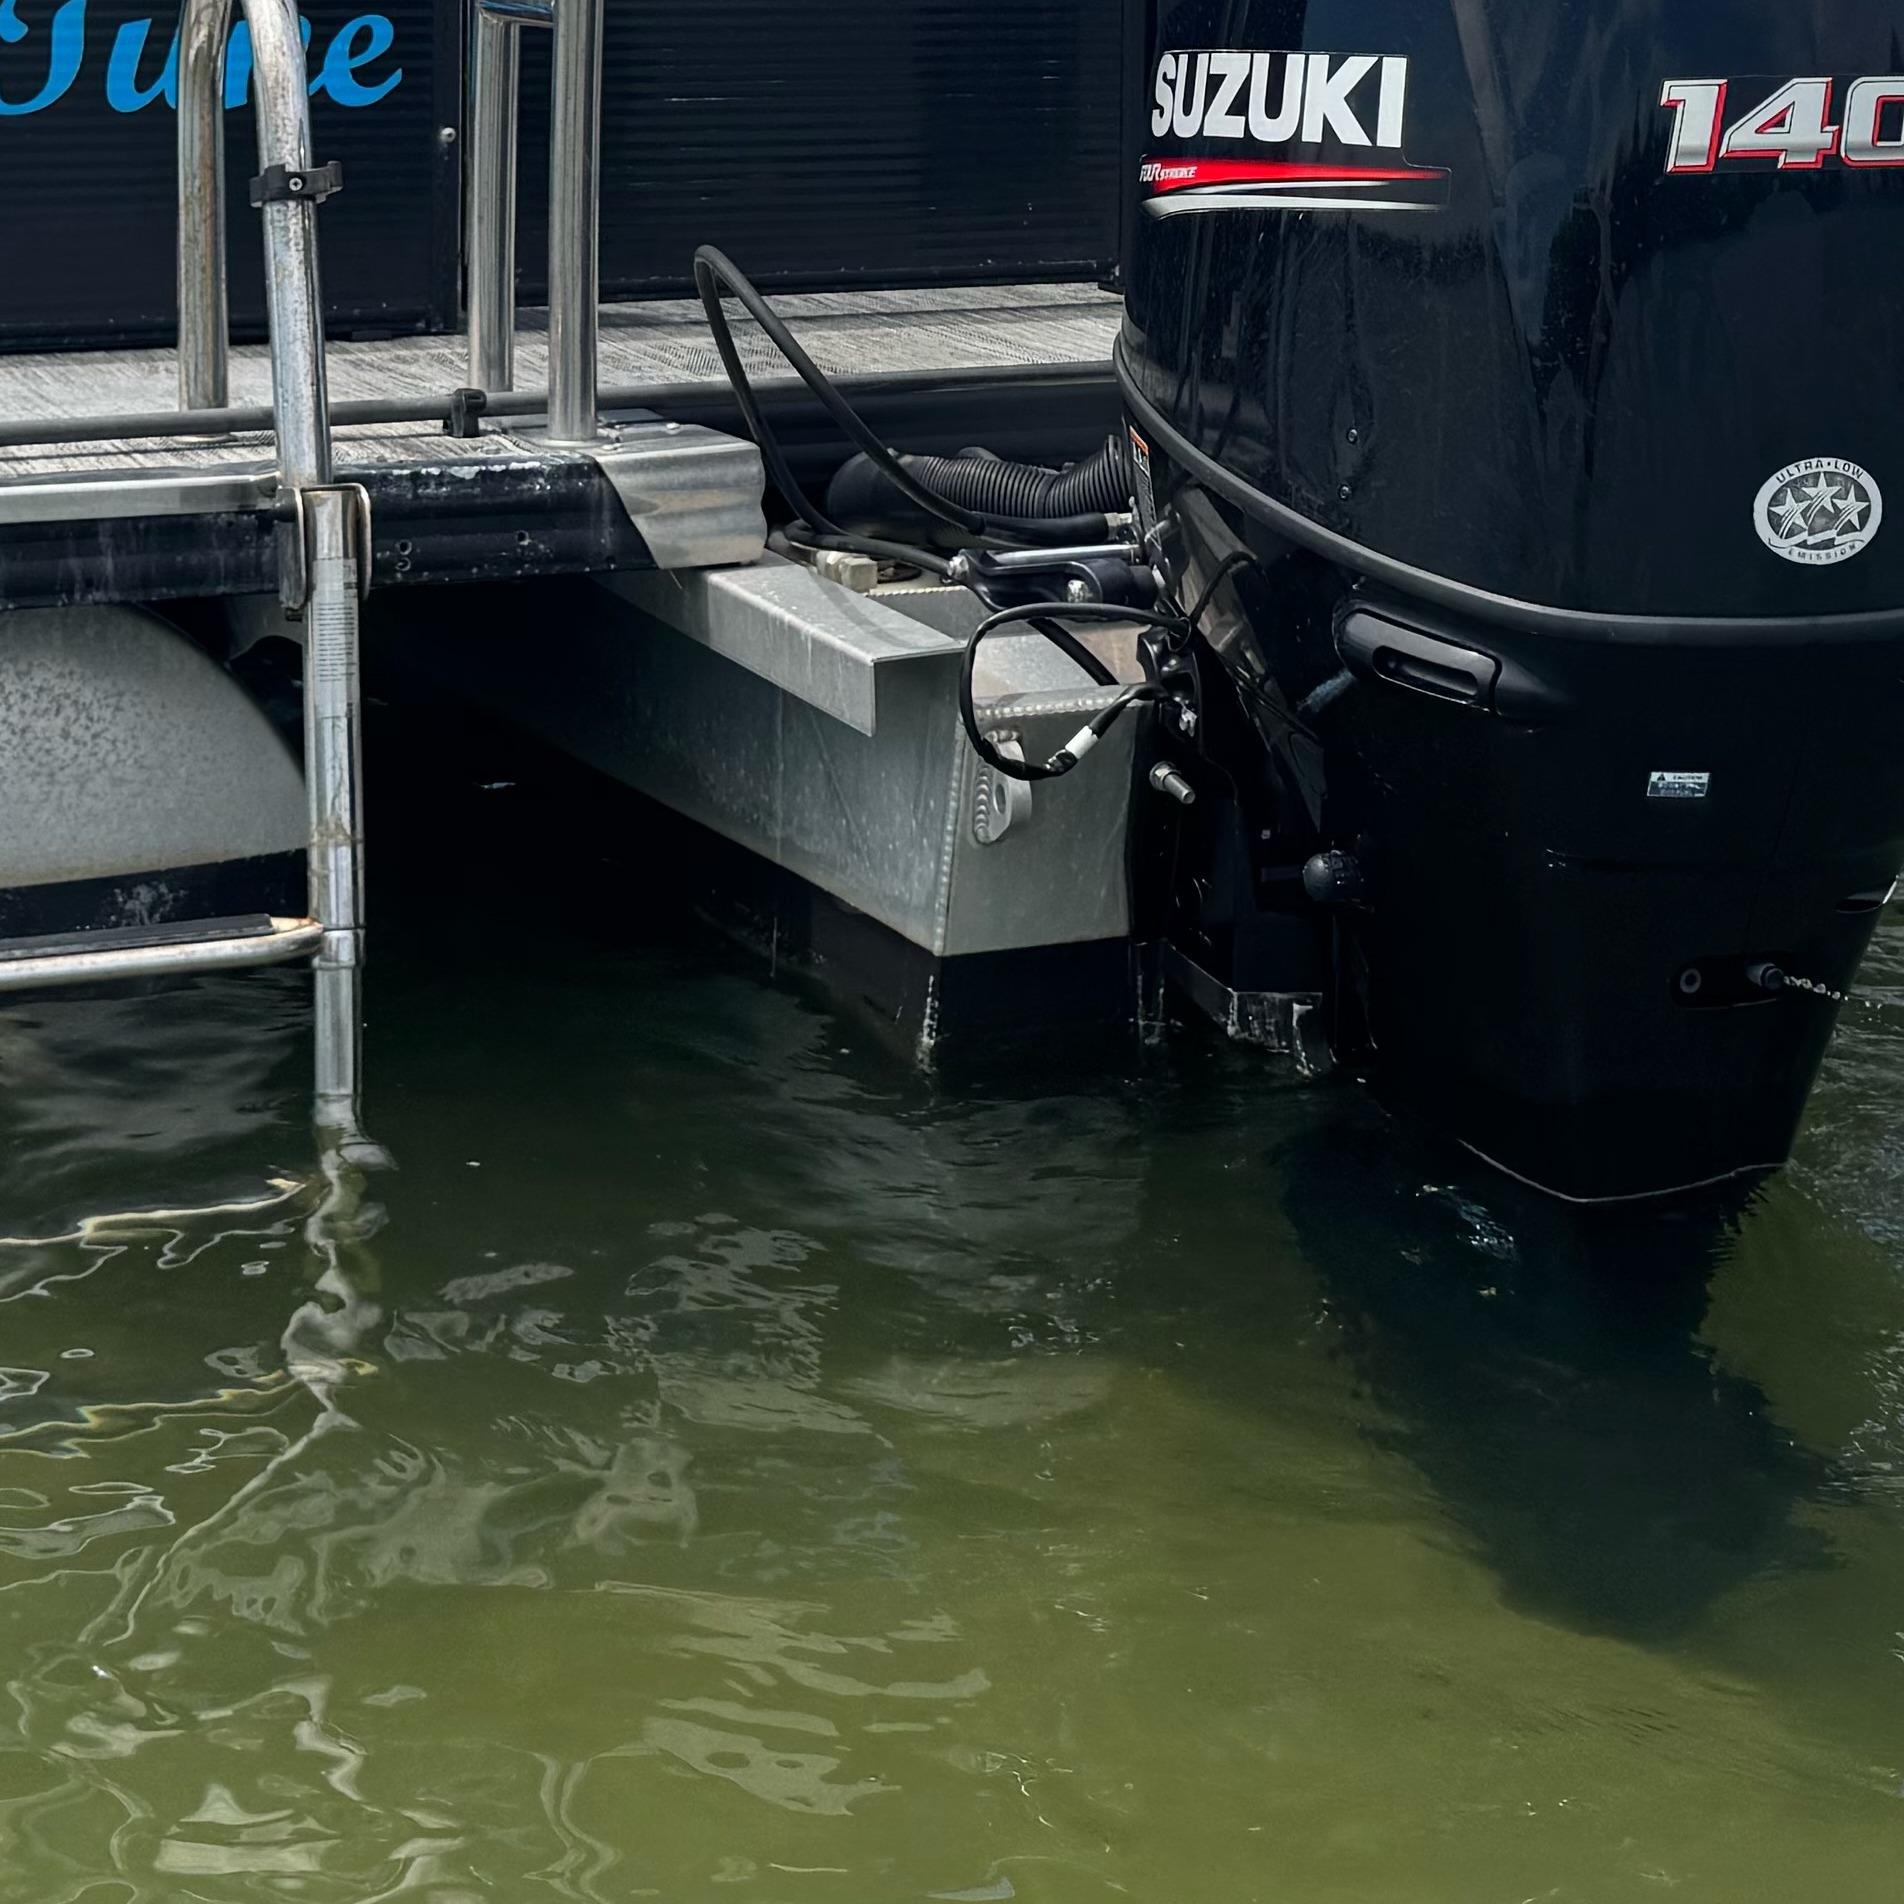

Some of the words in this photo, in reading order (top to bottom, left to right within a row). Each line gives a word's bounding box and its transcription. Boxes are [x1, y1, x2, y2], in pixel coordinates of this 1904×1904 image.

[1151, 53, 1407, 148] SUZUKI
[1776, 459, 1823, 484] ULTRA
[1834, 459, 1864, 479] LOW
